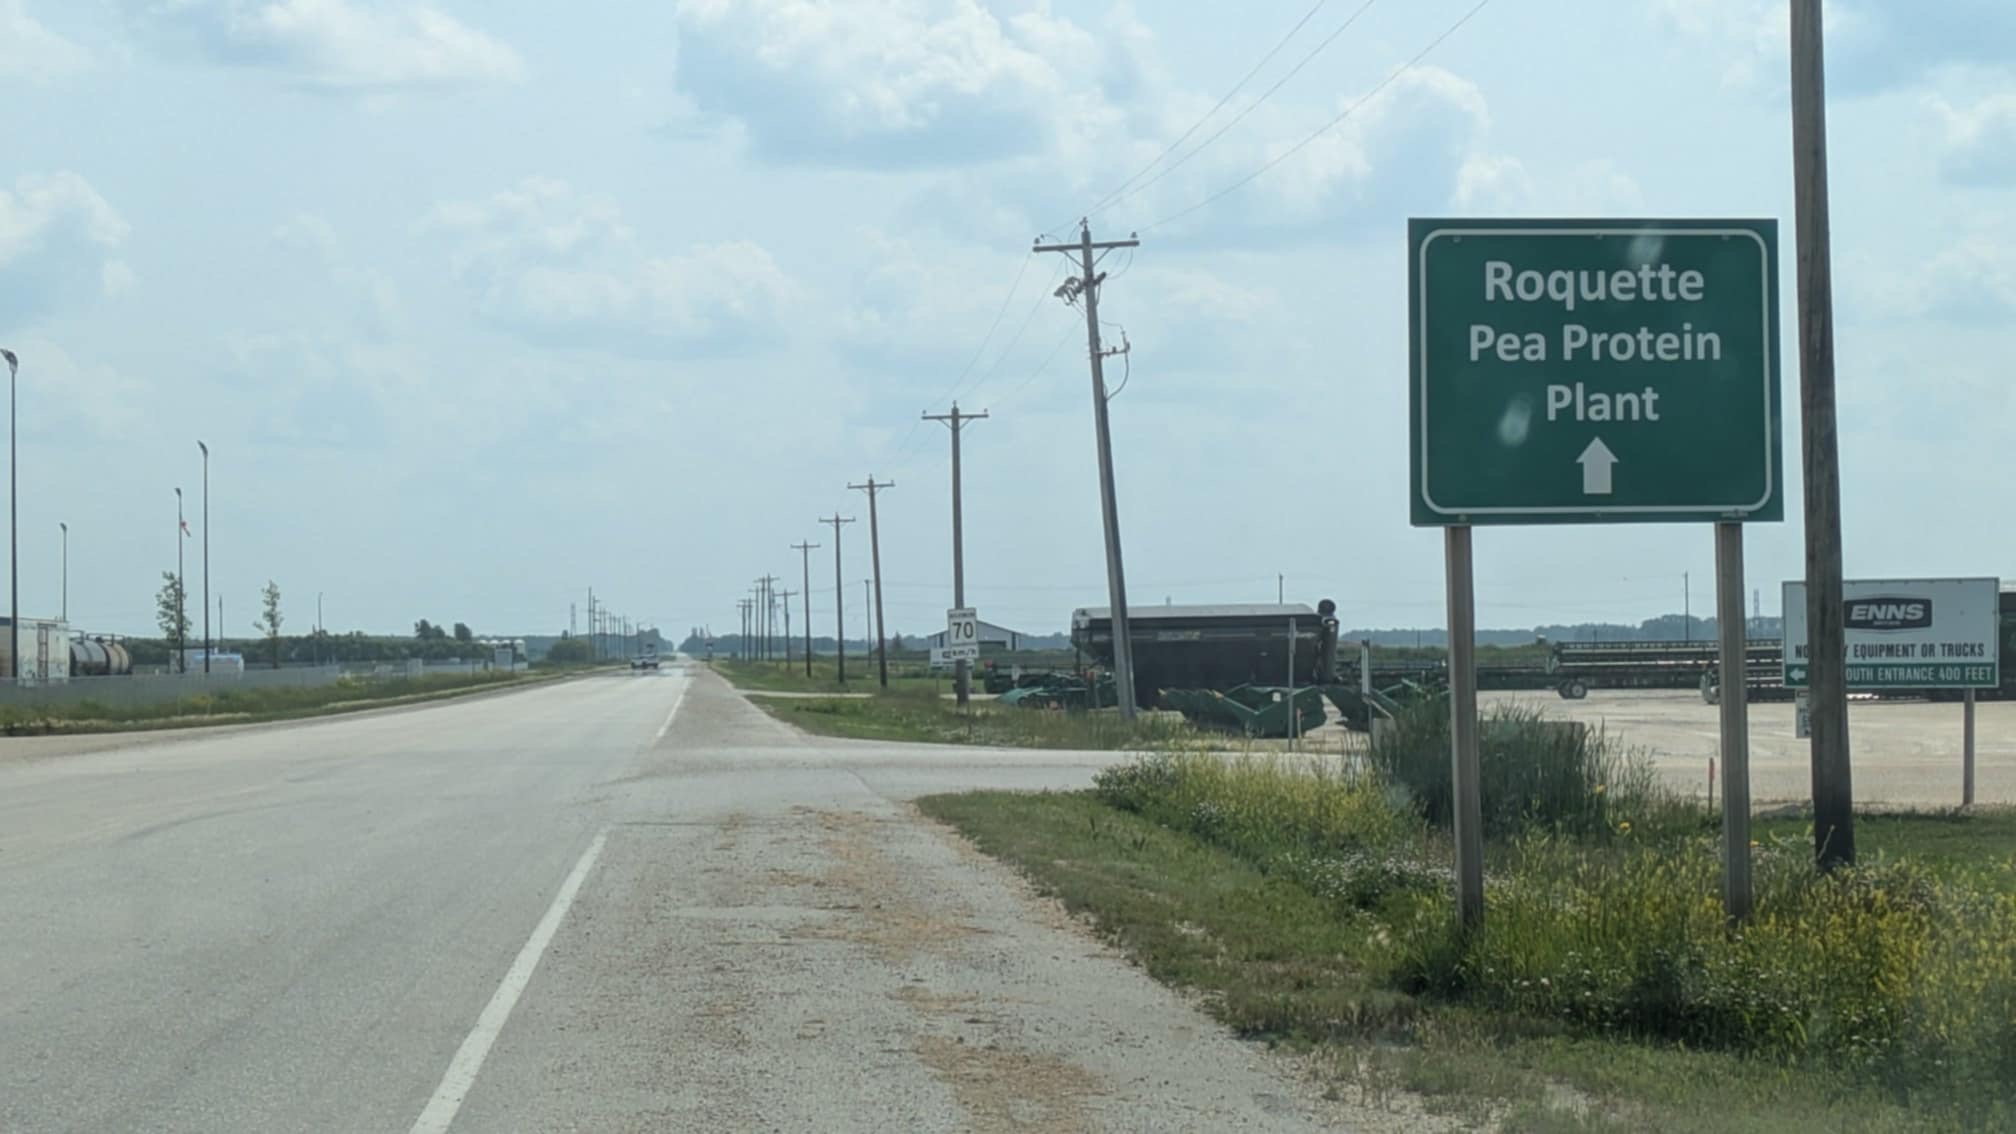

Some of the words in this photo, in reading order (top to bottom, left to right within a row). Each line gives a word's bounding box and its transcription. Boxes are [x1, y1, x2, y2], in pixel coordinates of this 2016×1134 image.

[1485, 260, 1705, 311] Roquette
[1469, 324, 1547, 361] Pea
[1562, 323, 1722, 361] Protein
[1546, 382, 1660, 421] Plant
[1851, 604, 1925, 620] ENNS
[952, 622, 974, 639] 70
[1853, 643, 1917, 660] EQUIPMENT
[1921, 643, 1936, 658] OR
[1941, 642, 1985, 657] TRUCKS
[1845, 667, 1874, 681] OUTH
[1878, 667, 1935, 681] ENTRANCE
[1939, 667, 1960, 681] 400
[1965, 666, 1993, 681] FEET
